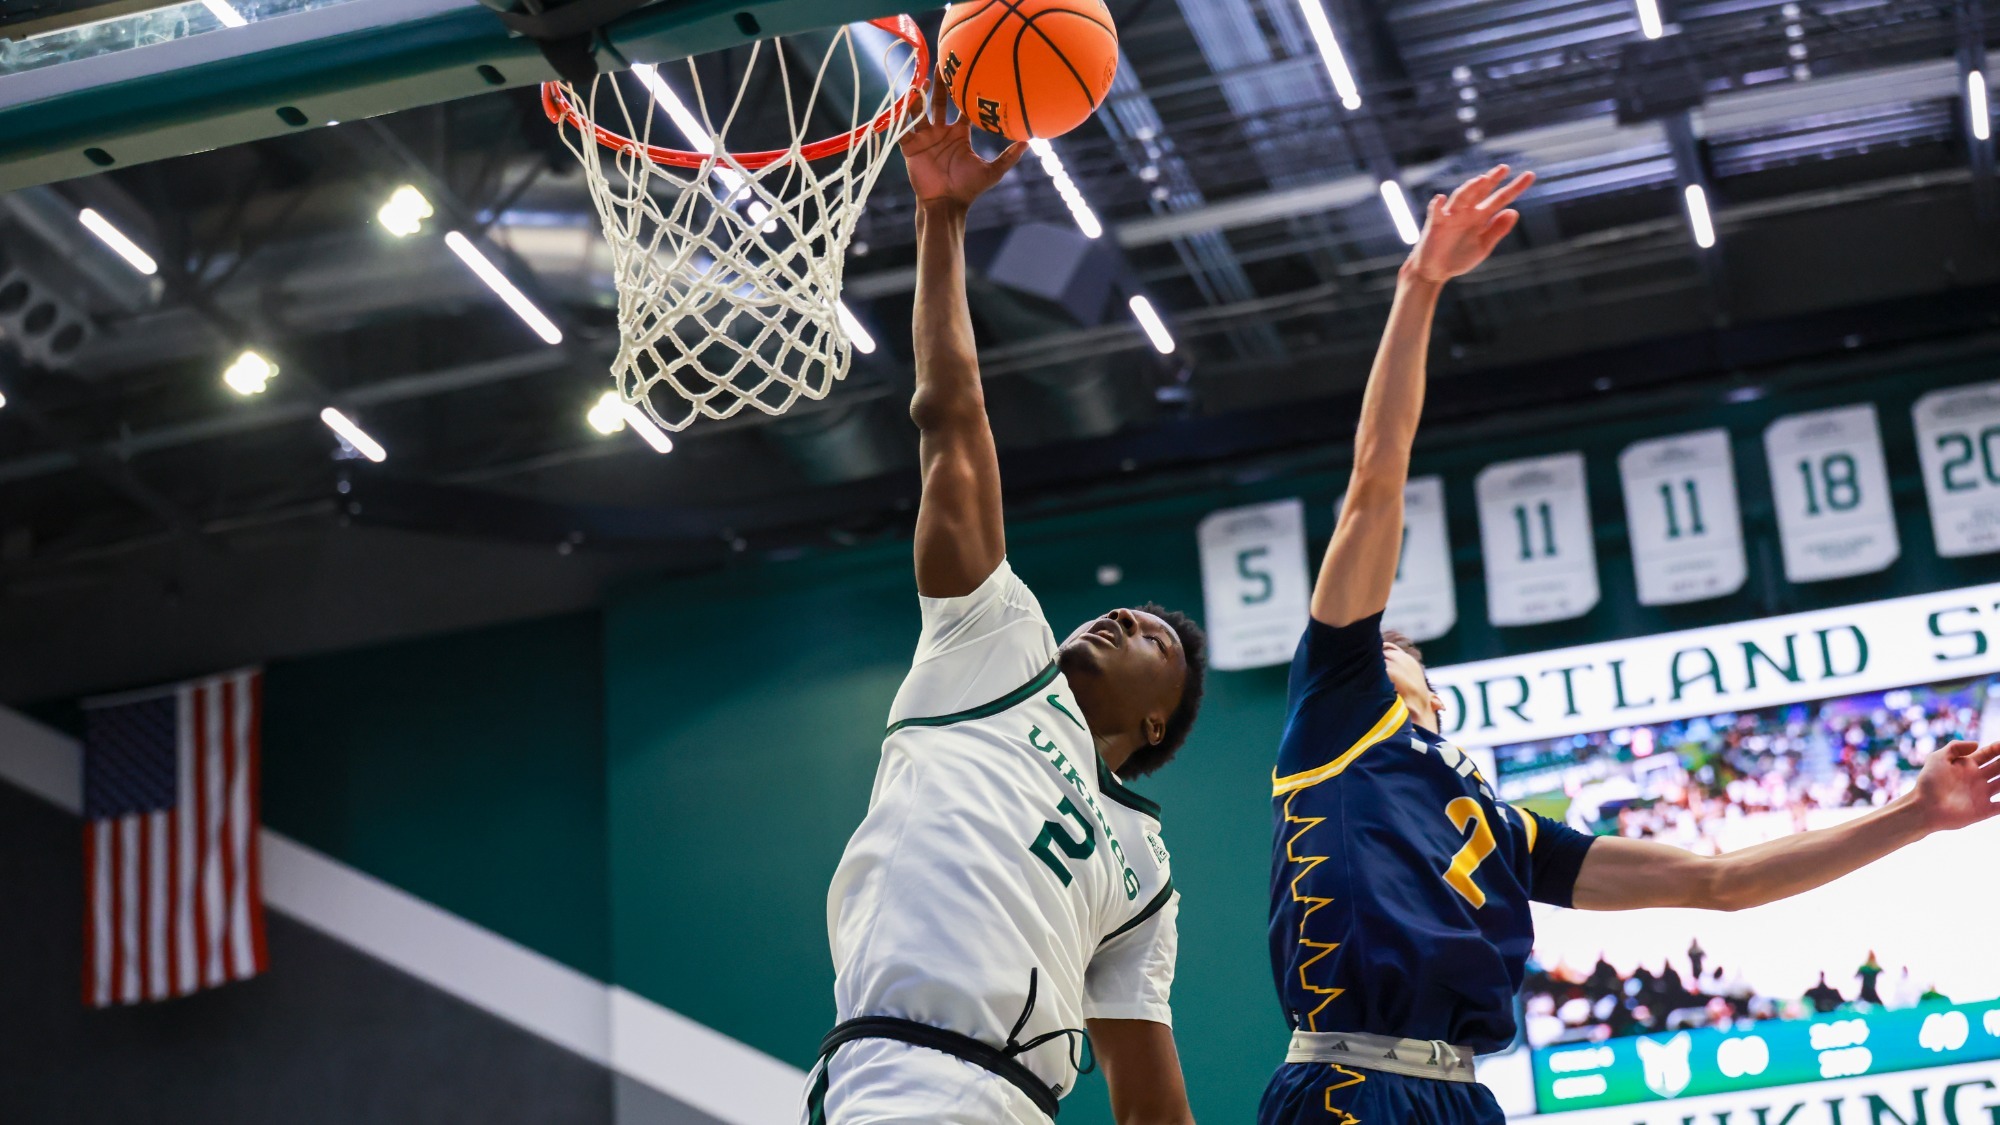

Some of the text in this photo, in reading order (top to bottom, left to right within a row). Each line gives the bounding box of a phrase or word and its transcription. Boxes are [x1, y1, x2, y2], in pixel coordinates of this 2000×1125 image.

[1660, 479, 1704, 537] 11
[1798, 453, 1861, 515] 18
[1513, 502, 1556, 560] 11
[1236, 547, 1274, 604] 5
[1928, 603, 2000, 660] S
[1028, 725, 1141, 901] VIKINGS
[1029, 795, 1096, 888] 2
[1442, 796, 1497, 910] 2
